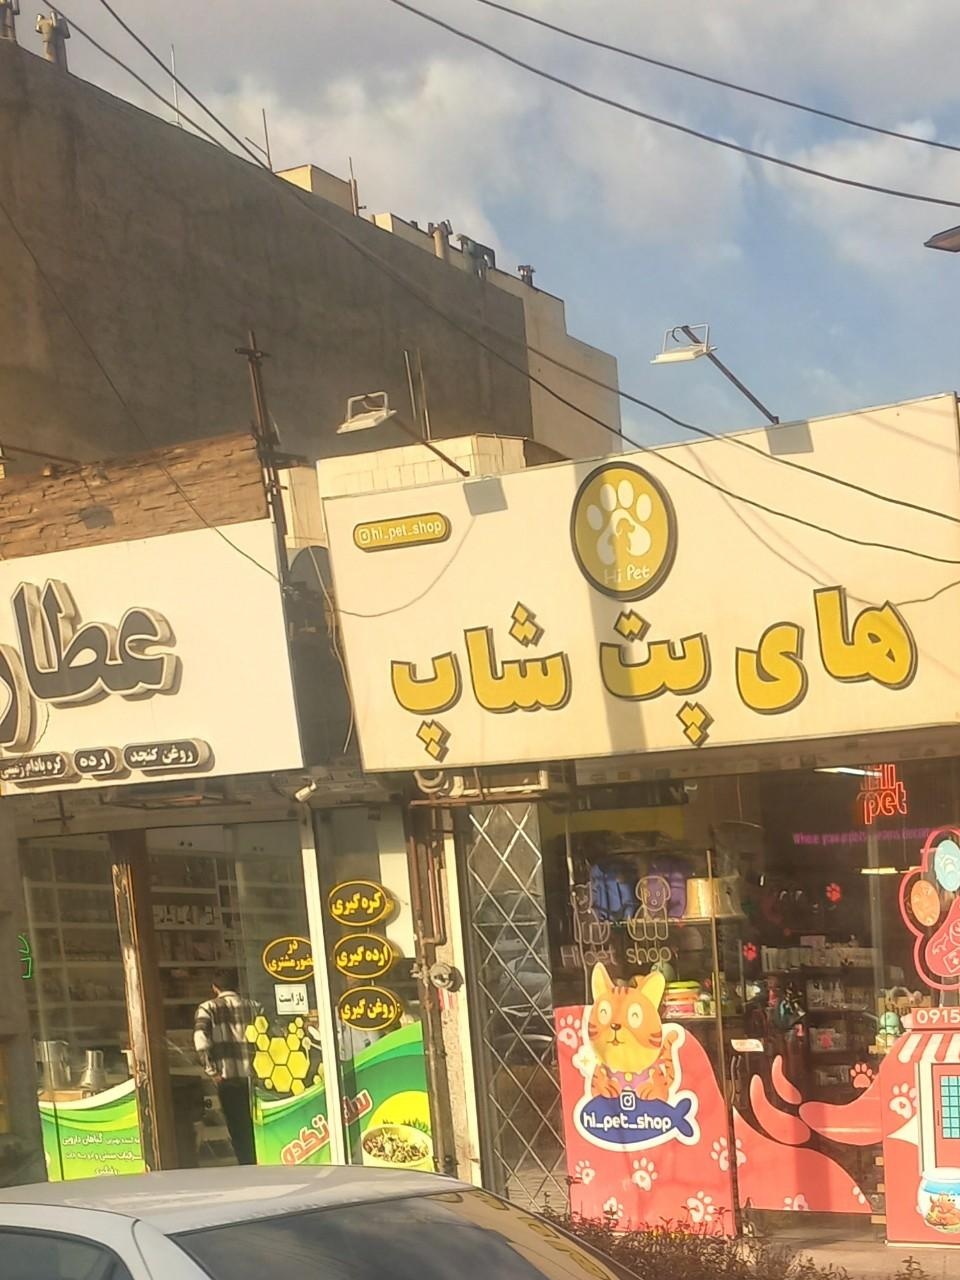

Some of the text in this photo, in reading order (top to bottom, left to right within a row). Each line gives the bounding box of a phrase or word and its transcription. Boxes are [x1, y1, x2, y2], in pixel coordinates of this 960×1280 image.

[626, 563, 650, 581] Pet
[390, 585, 919, 762] های پت شاپ
[47, 755, 62, 774] کره
[79, 751, 111, 770] ارده
[129, 744, 193, 767] روغن کنجد
[863, 781, 908, 825] pet
[331, 892, 382, 916] کره گیری
[287, 940, 298, 954] در
[336, 944, 388, 968] ارده گیری
[340, 997, 396, 1020] روغن گیری
[583, 1112, 672, 1132] hi_pet_shop
